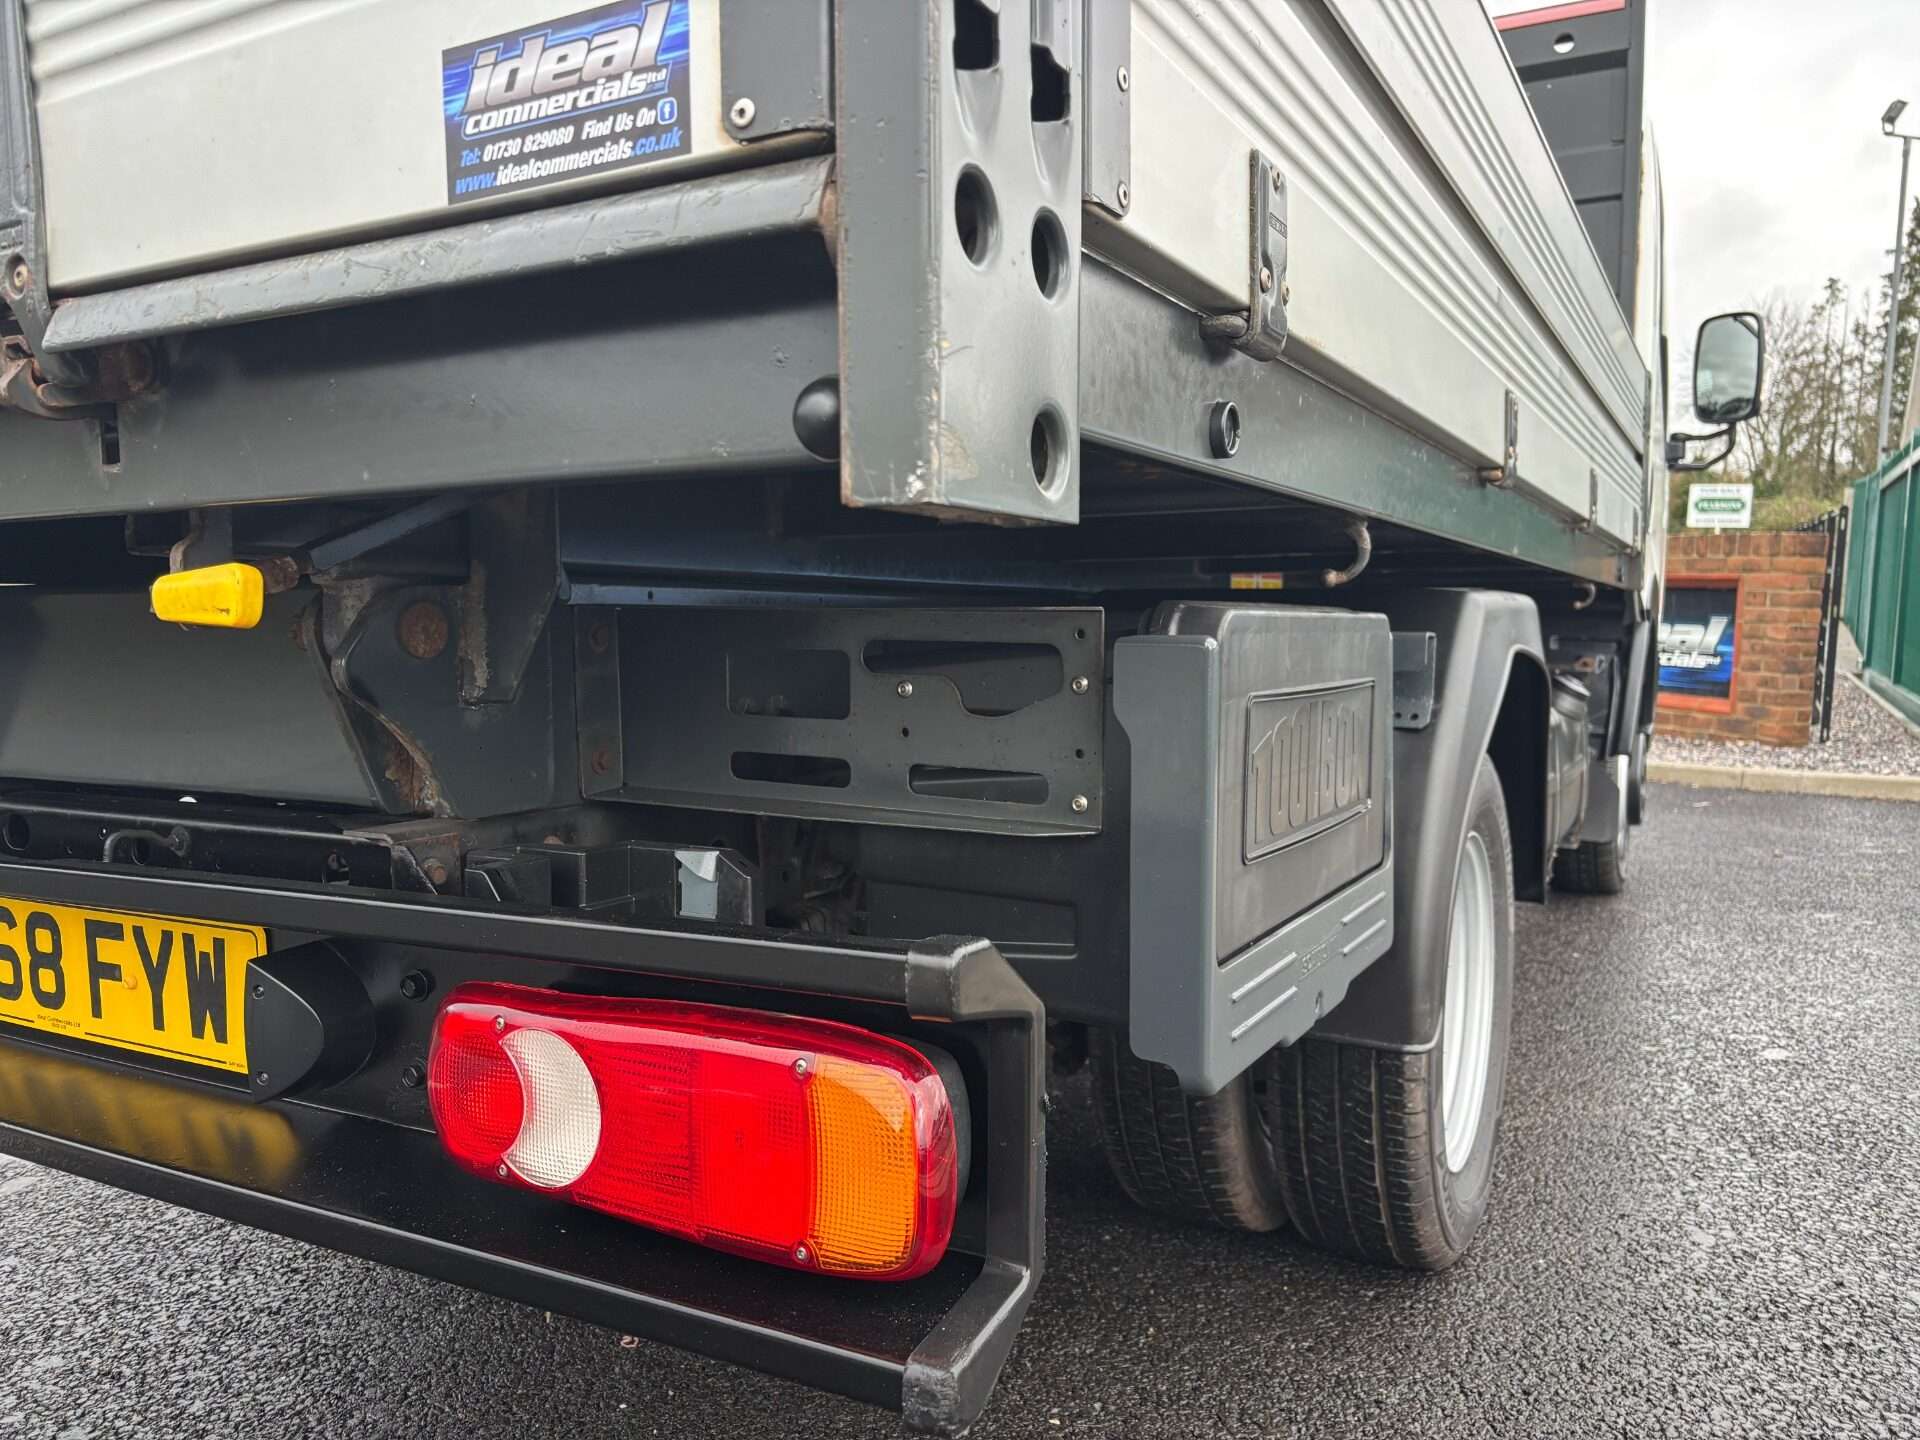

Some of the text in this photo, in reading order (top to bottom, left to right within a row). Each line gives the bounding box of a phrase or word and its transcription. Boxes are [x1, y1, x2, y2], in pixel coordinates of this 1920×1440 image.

[464, 0, 671, 113] ideal
[465, 68, 667, 135] commercials ltd
[456, 127, 683, 194] www.idealcommercials.co.uk
[461, 147, 481, 168] Tel:
[483, 138, 522, 162] 01730
[523, 125, 575, 153] 829080
[582, 115, 614, 140] Find
[615, 112, 634, 132] Us
[636, 107, 657, 128] On
[84, 918, 229, 1044] FYW
